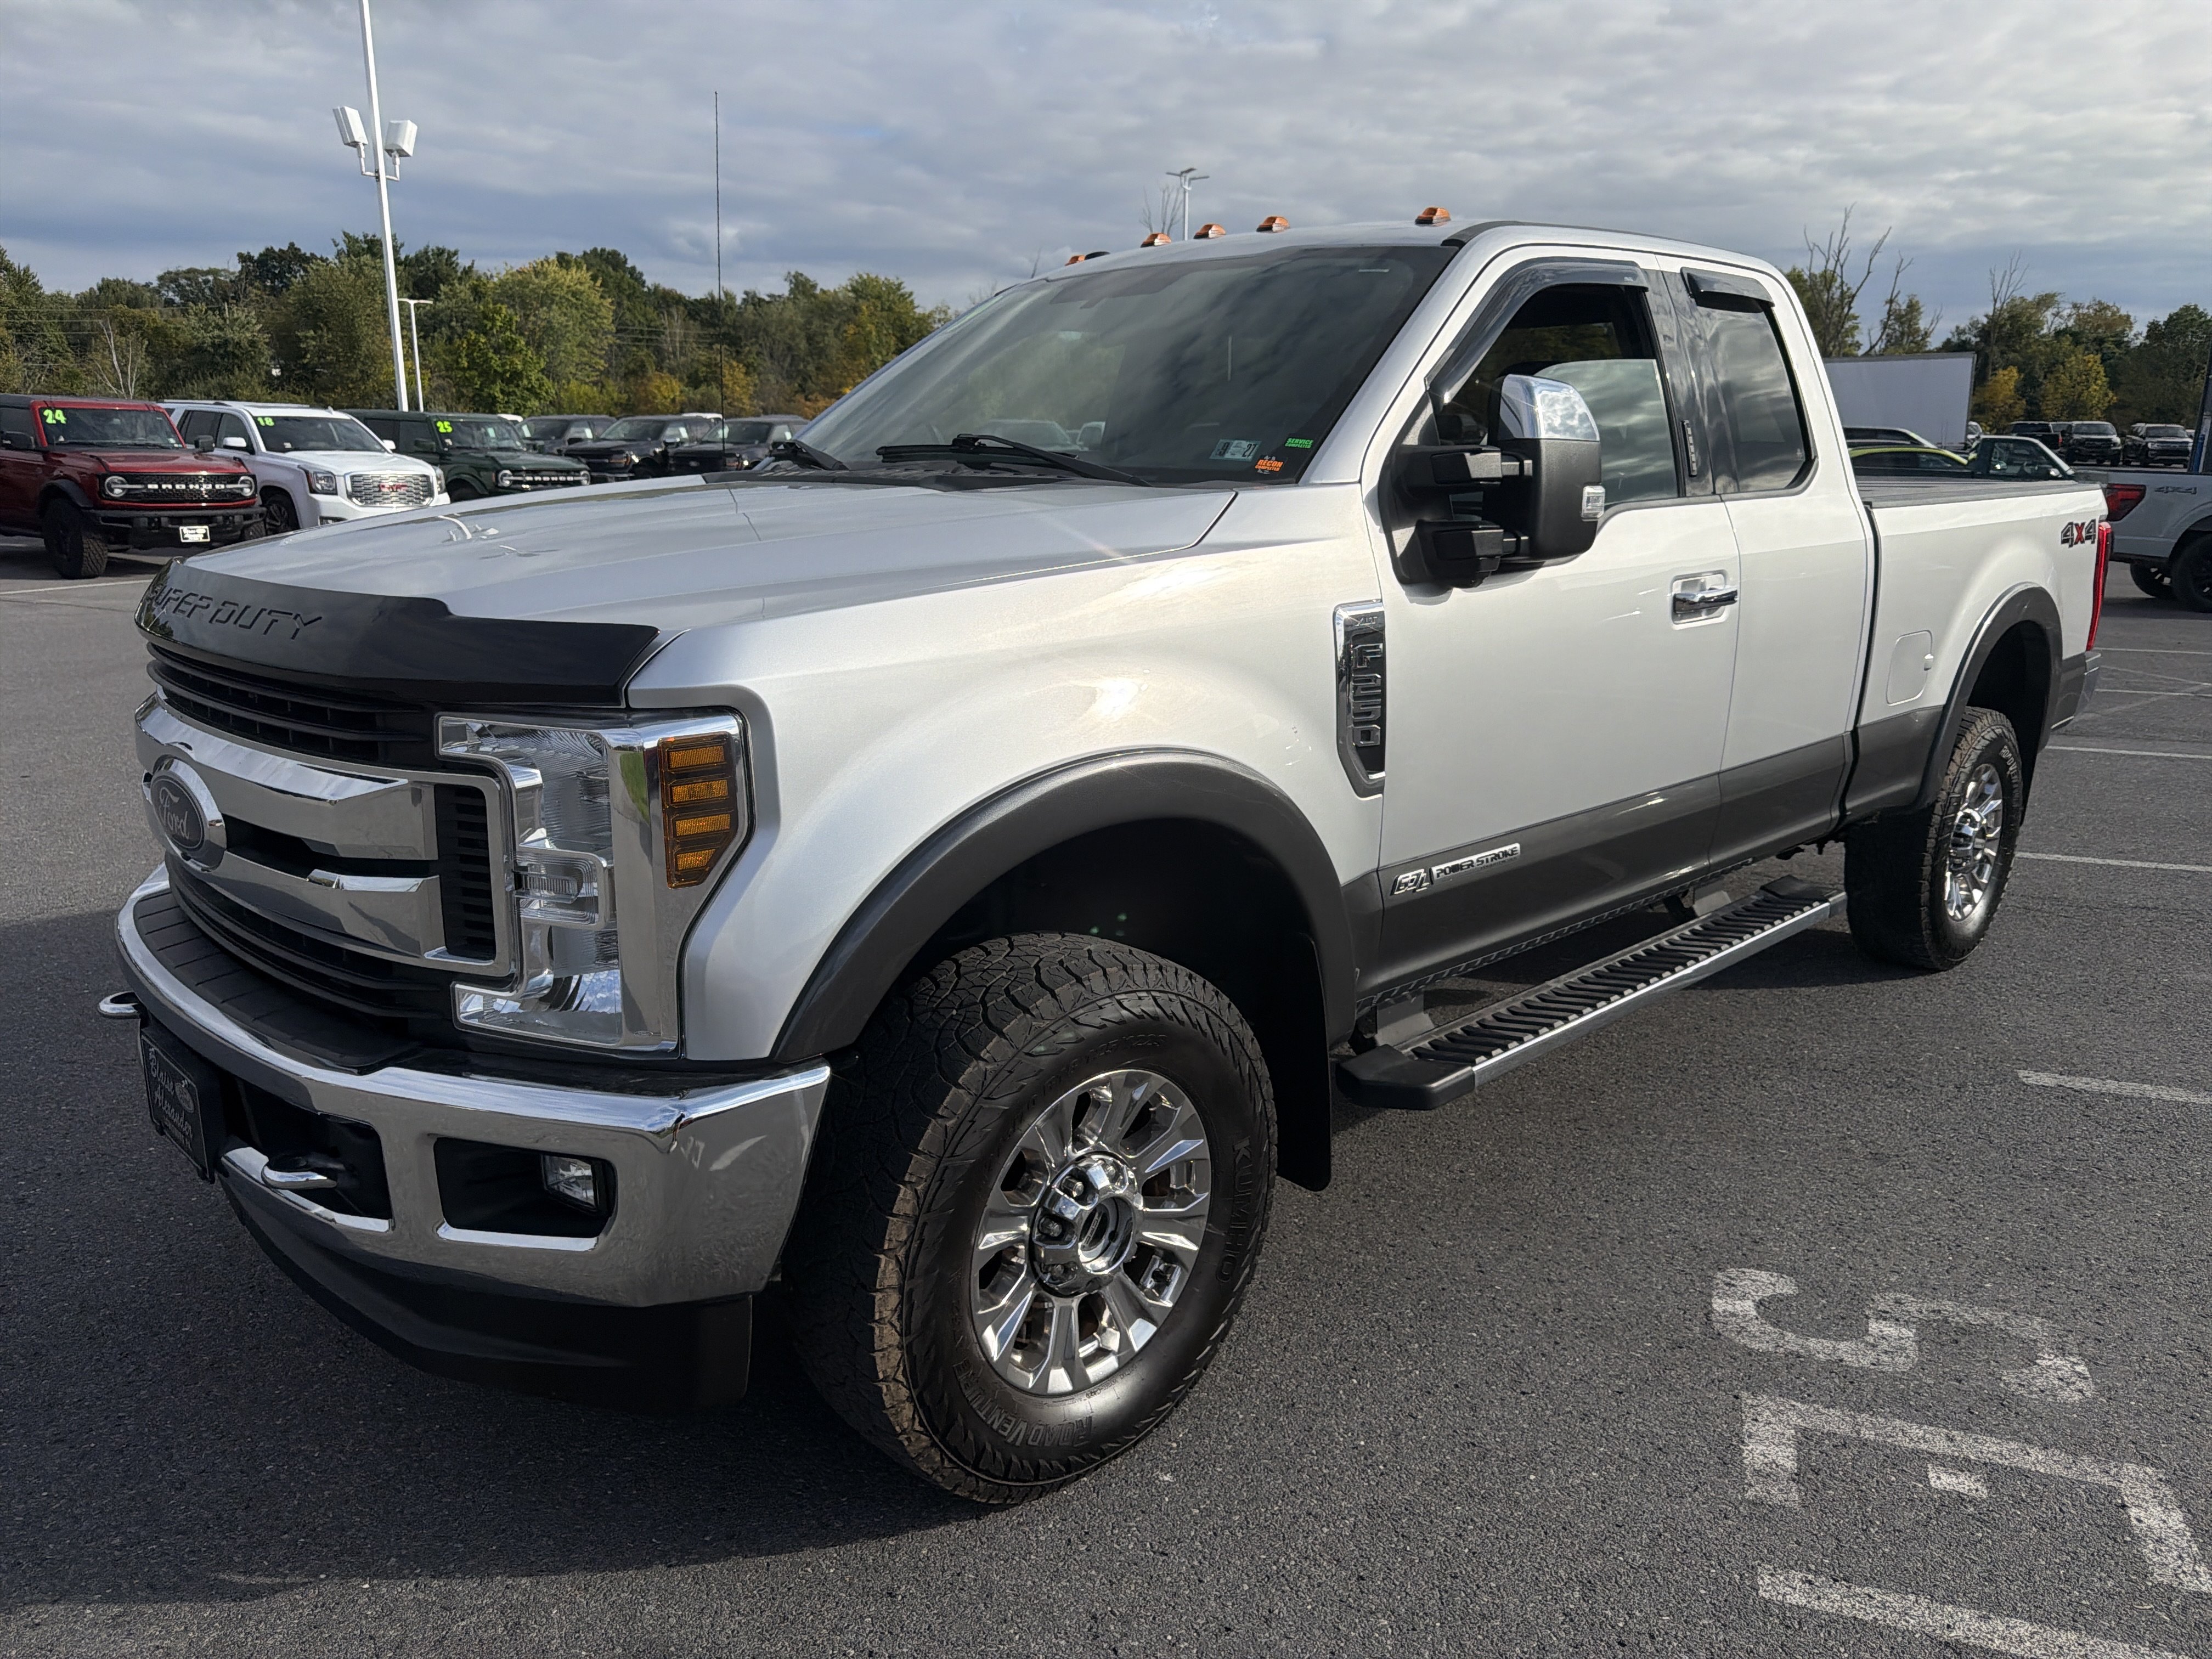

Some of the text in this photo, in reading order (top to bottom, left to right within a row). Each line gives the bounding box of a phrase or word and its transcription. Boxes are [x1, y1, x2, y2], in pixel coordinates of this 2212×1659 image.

[43, 409, 67, 424] 24
[257, 416, 275, 426] 18
[436, 421, 453, 433] 25
[1242, 444, 1257, 458] 27
[1257, 459, 1284, 467] RECON
[208, 600, 323, 640] DUTY
[159, 787, 190, 840] Ford
[1435, 859, 1474, 878] POWER
[1476, 846, 1519, 866] STROKE
[1216, 1137, 1252, 1283] KUMHO
